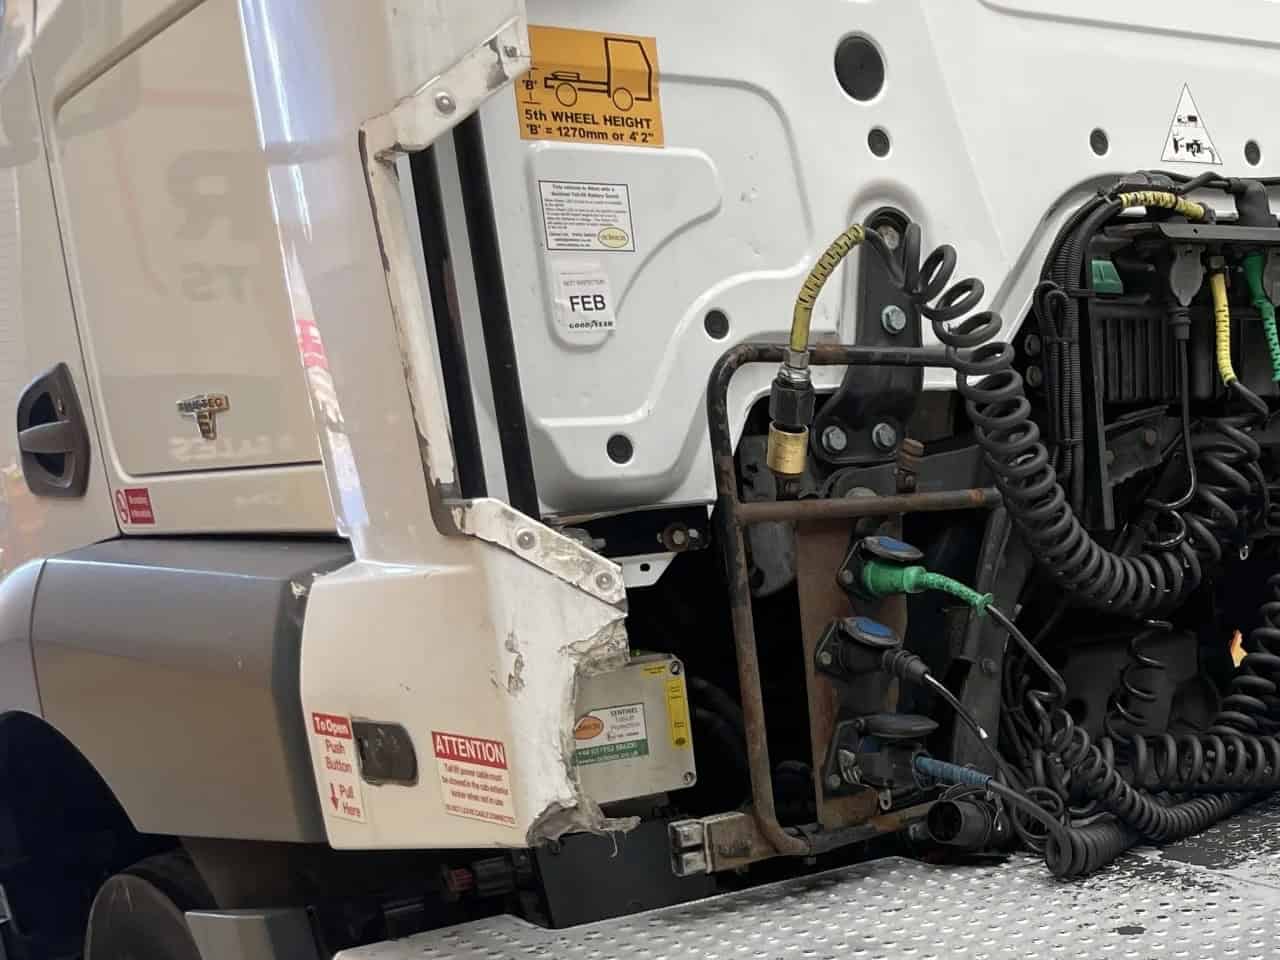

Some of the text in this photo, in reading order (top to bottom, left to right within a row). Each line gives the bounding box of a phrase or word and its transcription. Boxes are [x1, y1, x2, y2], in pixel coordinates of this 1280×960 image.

[525, 109, 653, 130] 5th WHEEL HEIGHT
[557, 127, 609, 141] 1270mm
[612, 132, 625, 142] or
[569, 294, 606, 312] FEB
[314, 716, 350, 736] To Open
[325, 739, 345, 754] Push
[435, 735, 505, 764] ATTENTION
[325, 756, 352, 773] Button
[339, 784, 354, 799] Pull
[343, 801, 361, 817] Here
